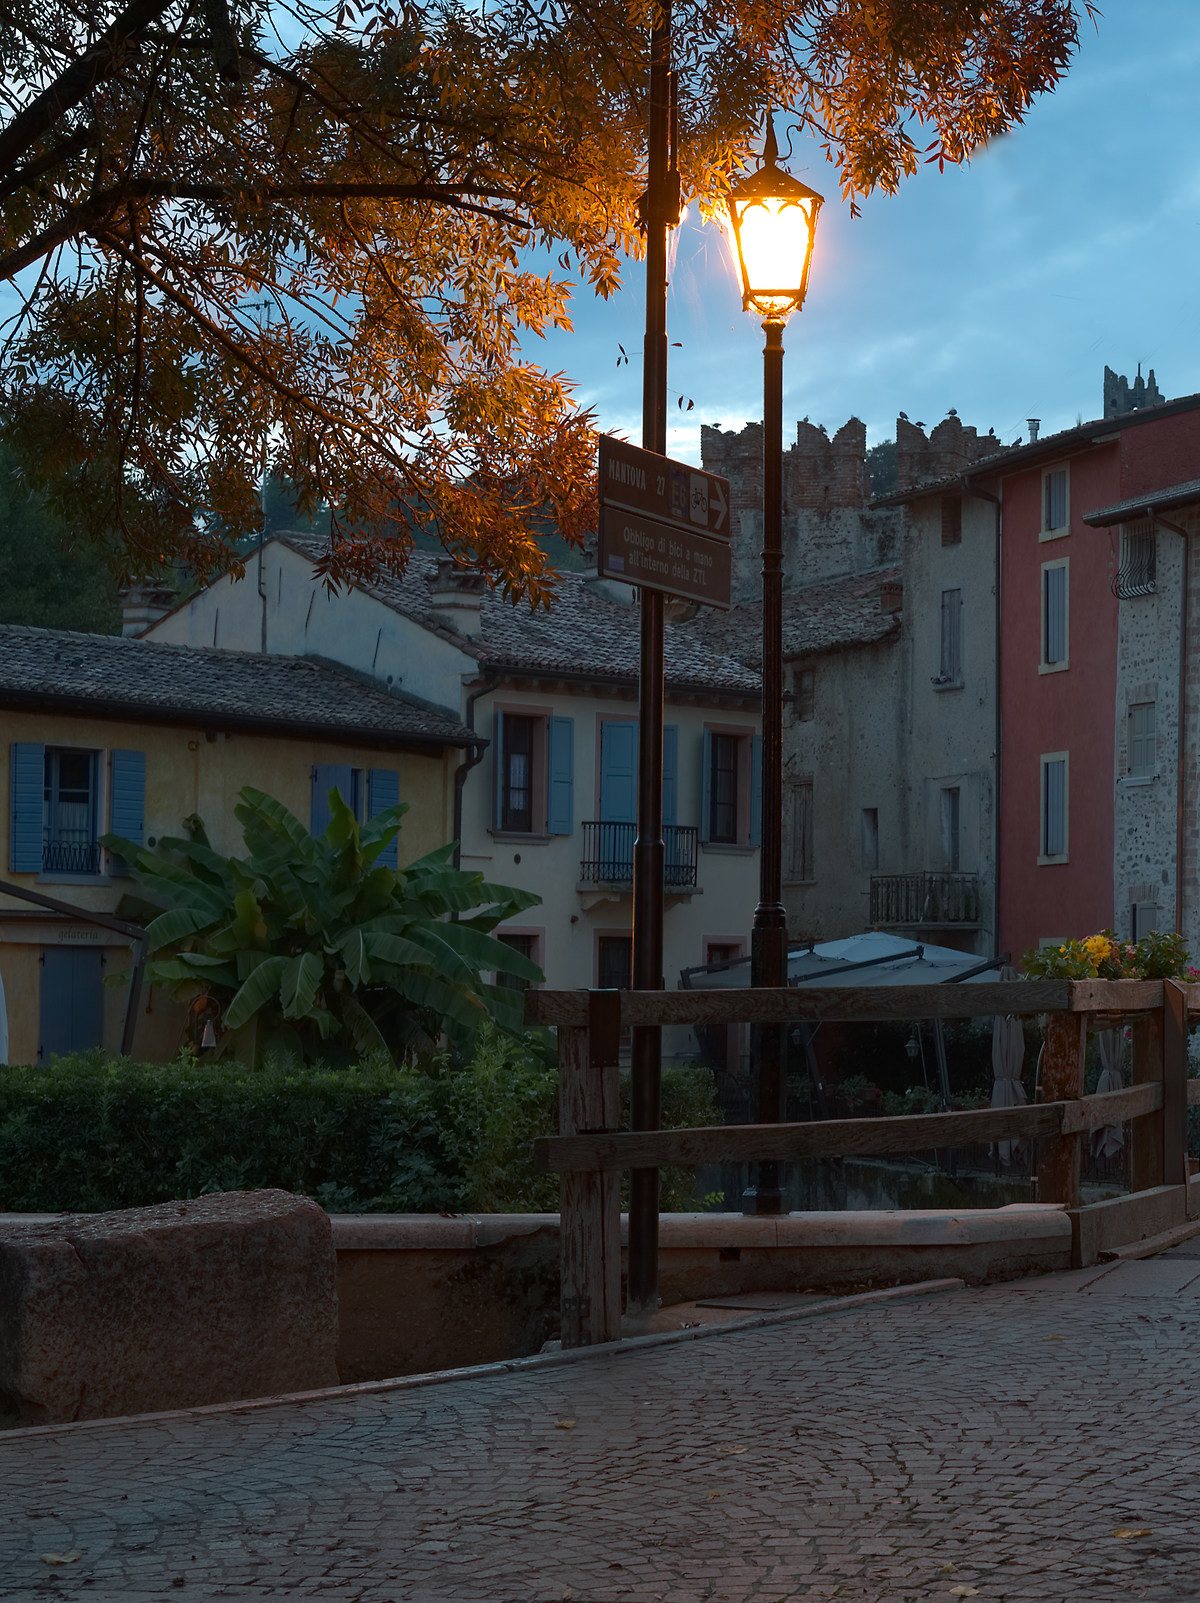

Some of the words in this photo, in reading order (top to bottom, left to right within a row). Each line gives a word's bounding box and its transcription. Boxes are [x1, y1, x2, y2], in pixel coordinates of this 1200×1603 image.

[608, 458, 646, 490] MANTOVA
[656, 475, 665, 496] 27
[671, 481, 686, 507] E6
[623, 526, 654, 551] Obbligo
[658, 536, 666, 553] di
[669, 539, 683, 558] bici
[686, 549, 691, 561] a
[693, 551, 713, 567] mano
[628, 550, 668, 574] all'interno
[672, 563, 690, 581] della
[693, 568, 707, 586] ZTL
[58, 926, 98, 943] gelateria
